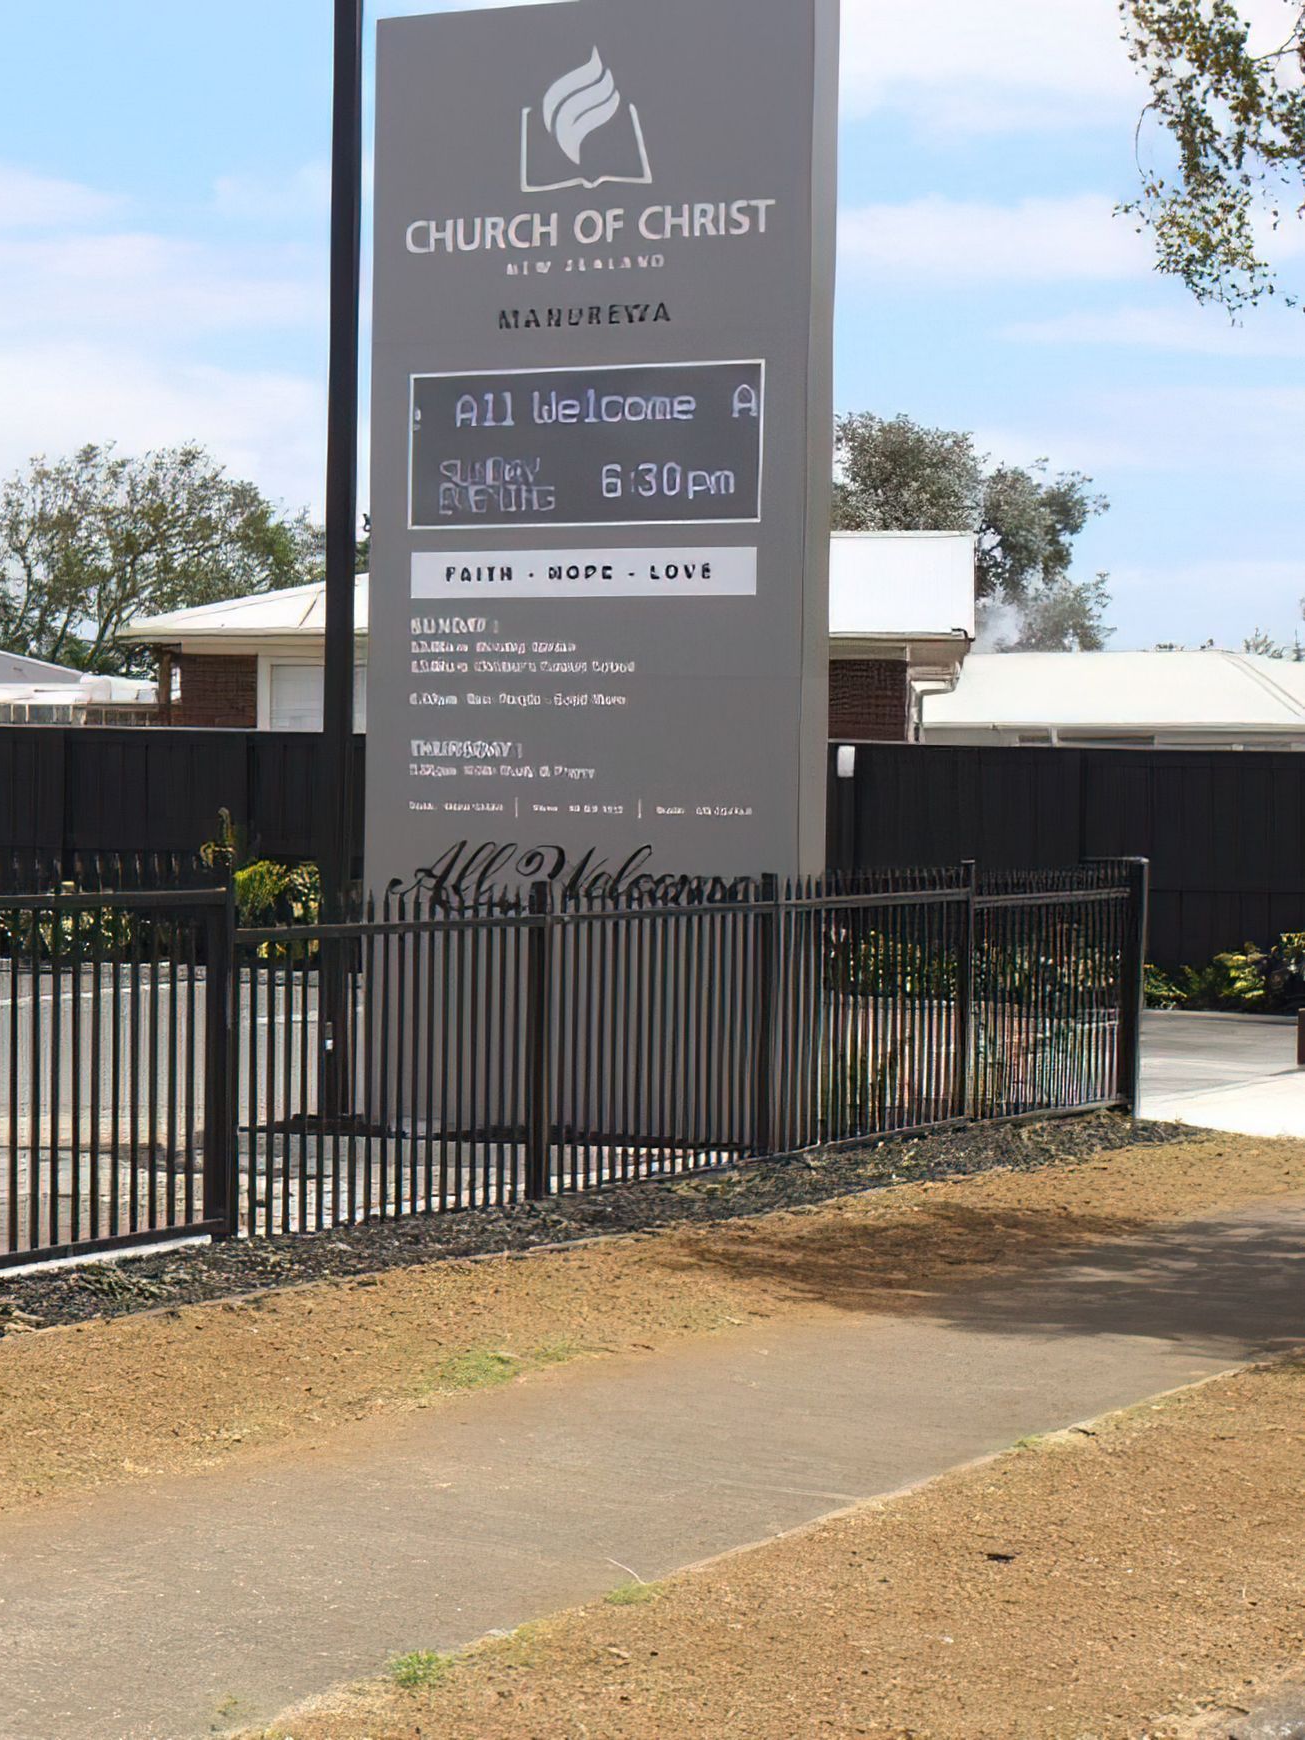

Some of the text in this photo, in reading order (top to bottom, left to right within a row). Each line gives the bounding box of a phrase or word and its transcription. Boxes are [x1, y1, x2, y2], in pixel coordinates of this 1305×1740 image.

[406, 198, 776, 254] CHURCH OF CHRIST
[498, 302, 671, 330] MANUREWA
[455, 391, 515, 428] All
[532, 388, 697, 425] Welcome
[445, 565, 513, 583] FAITH
[649, 562, 712, 581] LOVE
